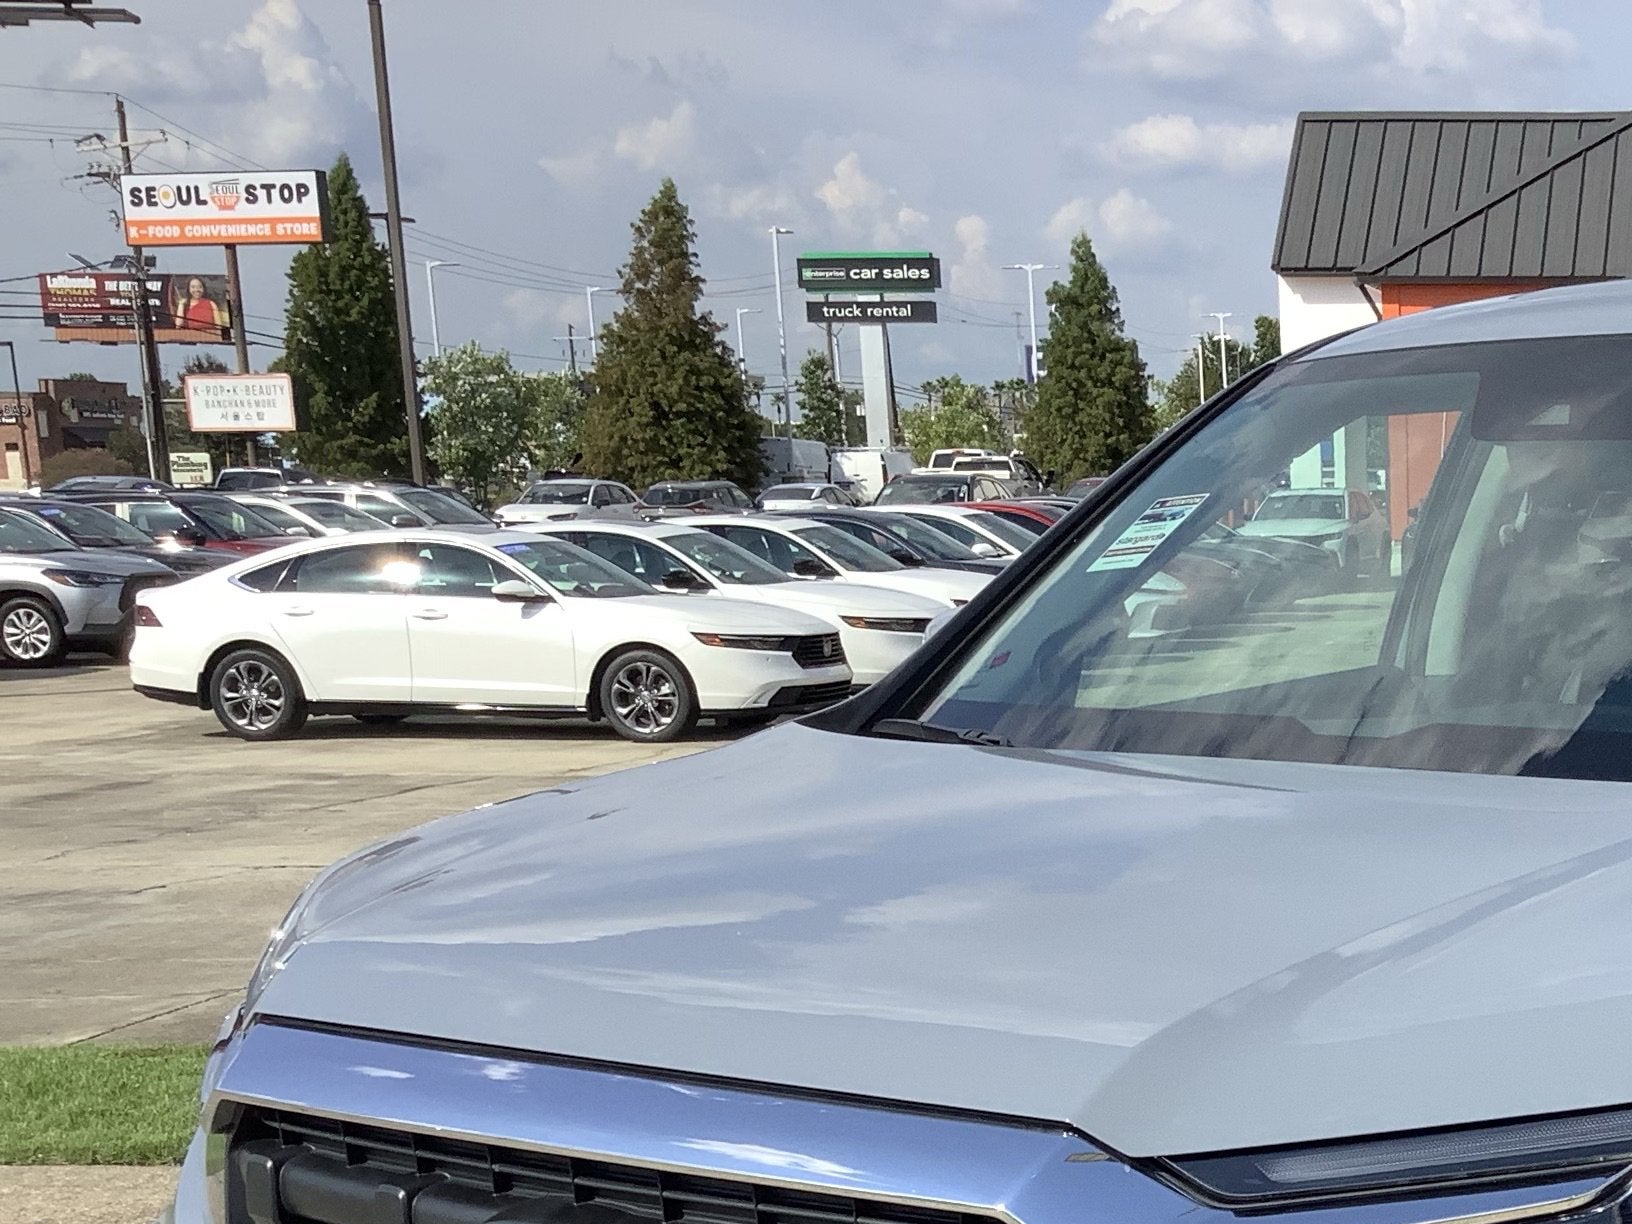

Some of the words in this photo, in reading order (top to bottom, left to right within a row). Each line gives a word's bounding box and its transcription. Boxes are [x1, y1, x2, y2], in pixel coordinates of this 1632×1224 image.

[129, 185, 208, 209] SEOUL
[245, 183, 310, 205] STOP
[129, 224, 180, 239] K-FOOD
[185, 223, 271, 238] CONVENIENCE
[276, 222, 318, 236] STORE
[804, 269, 845, 279] enterprise
[850, 268, 879, 279] car
[883, 264, 931, 279] sales
[822, 304, 862, 317] truck
[867, 303, 912, 317] rental
